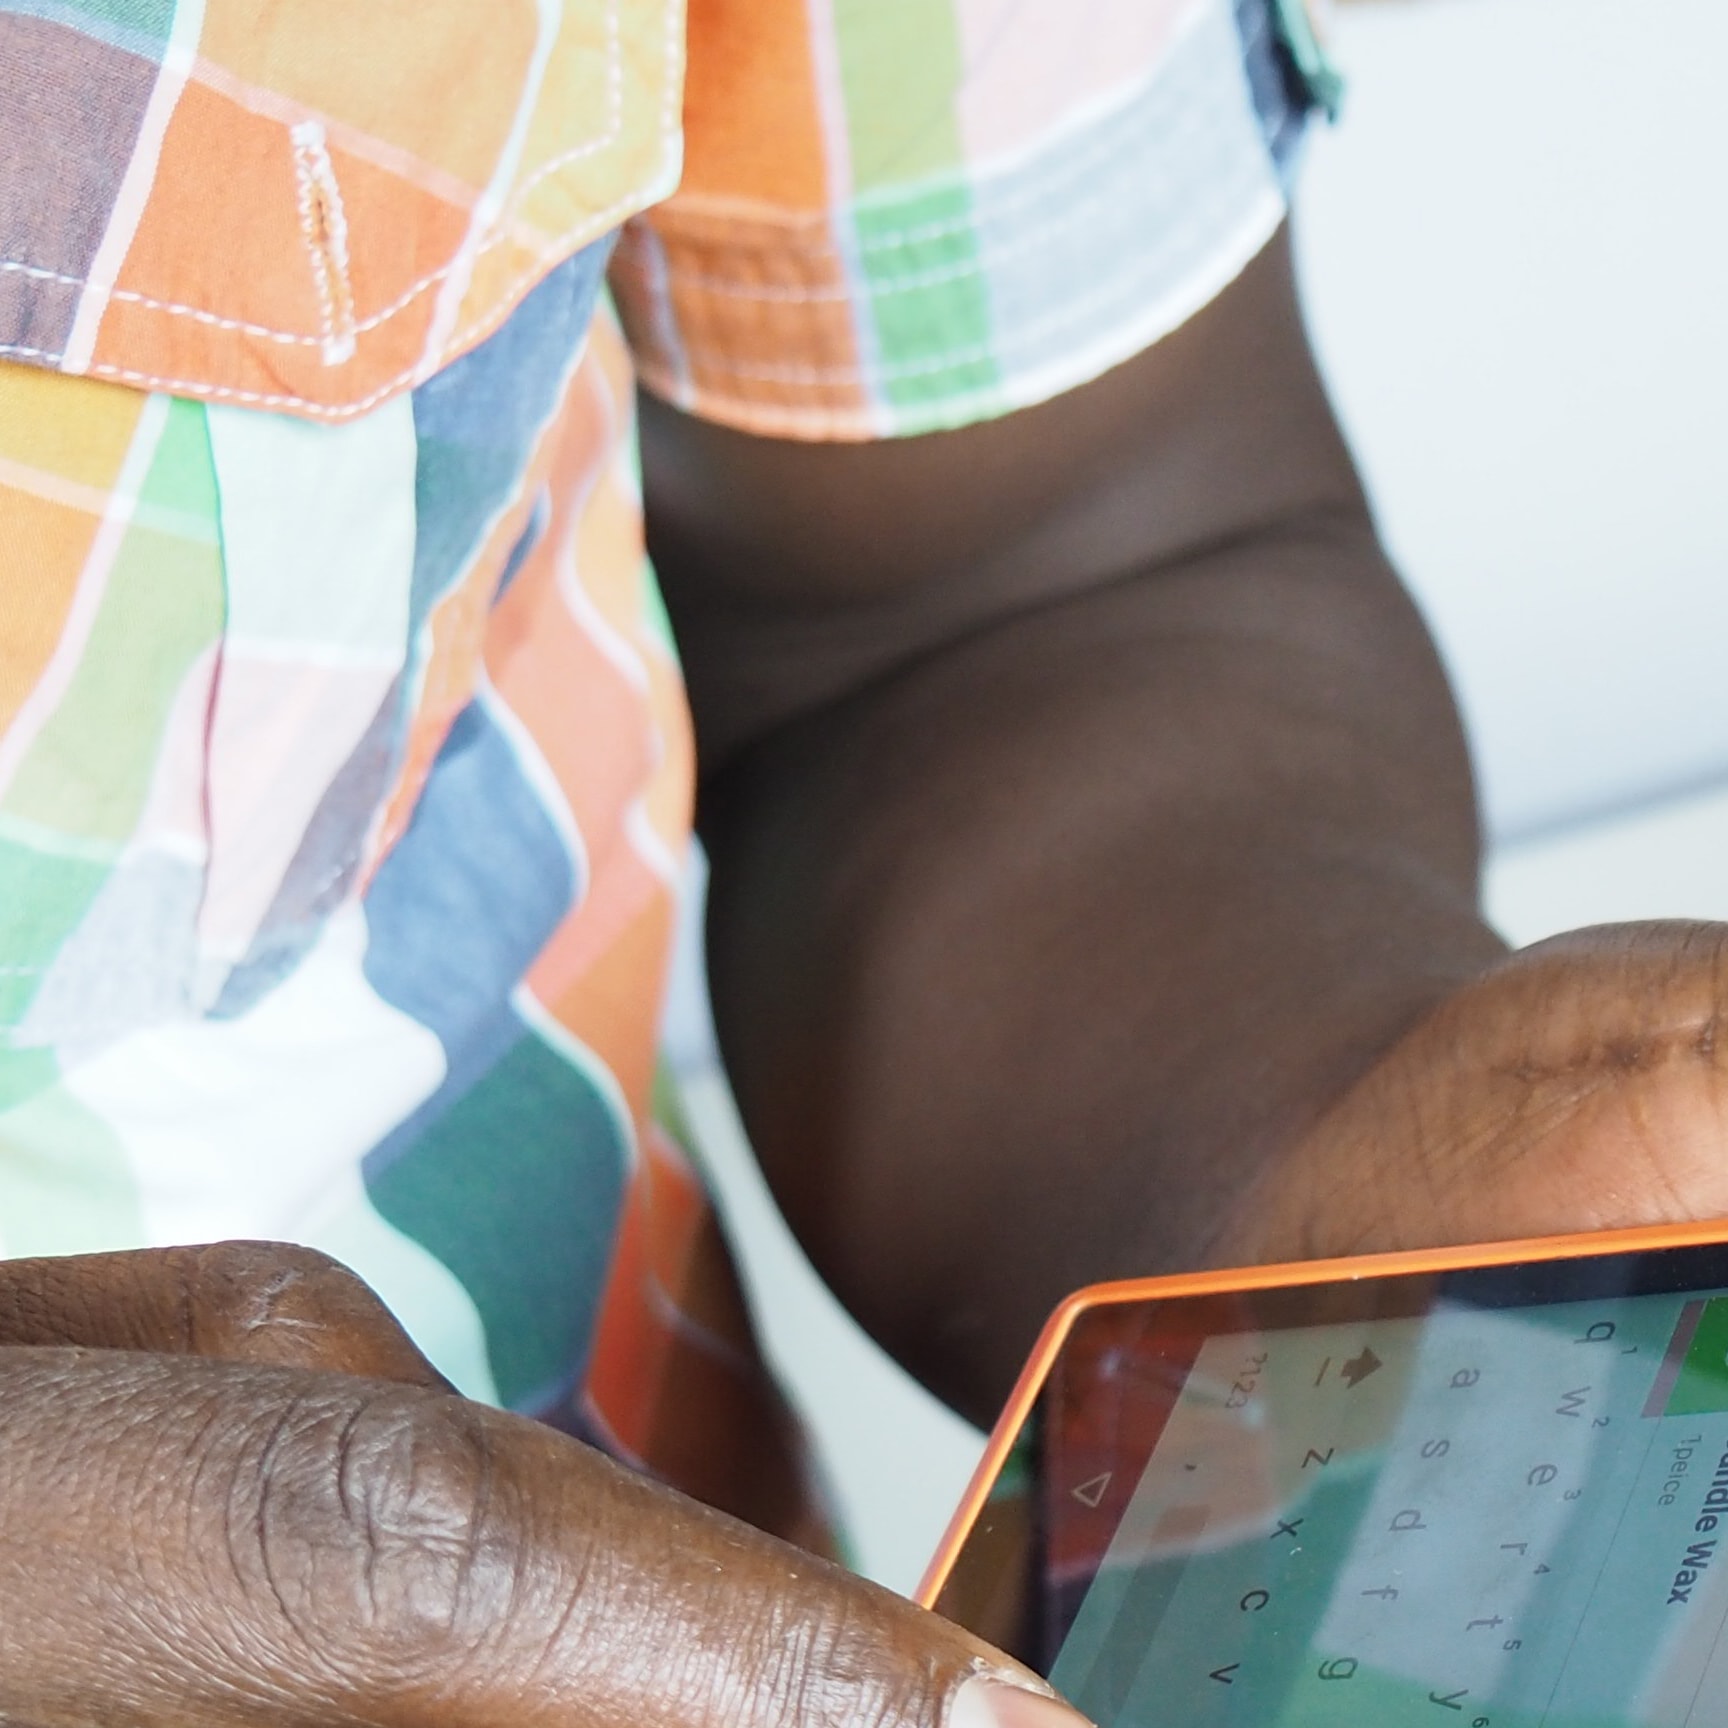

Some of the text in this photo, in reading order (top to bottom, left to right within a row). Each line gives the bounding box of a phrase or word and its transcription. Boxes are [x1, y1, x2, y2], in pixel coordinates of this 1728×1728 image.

[1573, 1321, 1616, 1345] q
[1224, 1352, 1268, 1409] ?123
[1448, 1367, 1482, 1391] a
[1554, 1387, 1592, 1419] w
[1301, 1447, 1334, 1469] z
[1420, 1437, 1450, 1460] s
[1527, 1462, 1560, 1488] e
[1658, 1448, 1694, 1506] peice
[1269, 1516, 1305, 1539] x
[1386, 1508, 1427, 1533] d
[1500, 1541, 1529, 1555] r
[1666, 1538, 1718, 1606] Wax
[1239, 1588, 1271, 1613] c
[1361, 1582, 1399, 1601] f
[1465, 1614, 1504, 1634] t
[1208, 1664, 1242, 1686] v
[1317, 1655, 1359, 1682] g
[1428, 1689, 1470, 1712] y
